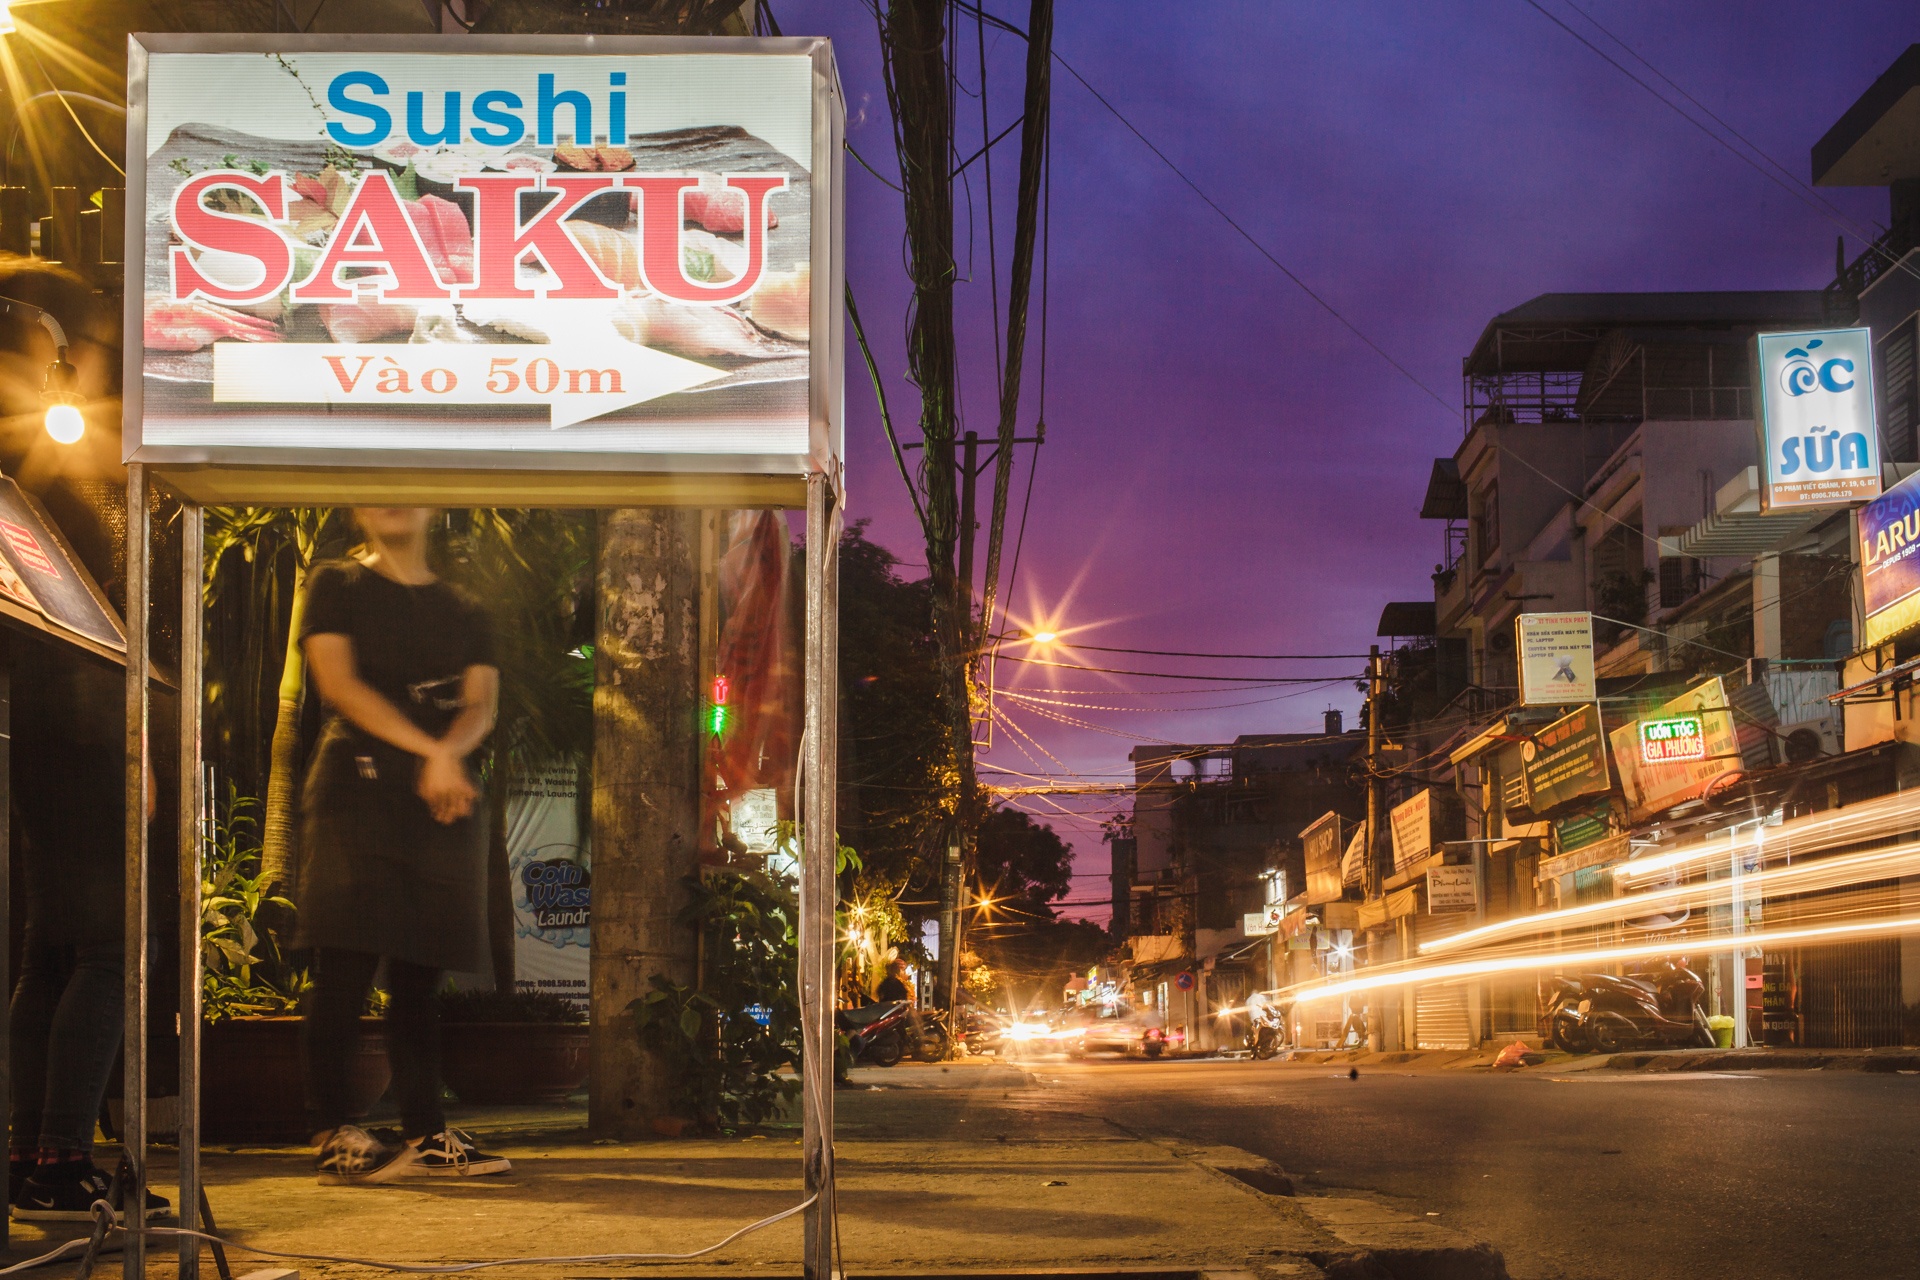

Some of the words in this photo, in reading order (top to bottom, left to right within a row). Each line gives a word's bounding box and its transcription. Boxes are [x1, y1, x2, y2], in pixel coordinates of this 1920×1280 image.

[326, 71, 627, 148] Sushi
[170, 172, 788, 302] SAKU
[322, 355, 458, 394] Vào
[486, 357, 627, 394] 50m
[1780, 425, 1869, 475] SỮA
[1783, 484, 1802, 494] PHẠM
[1802, 481, 1817, 491] VIẾT
[1882, 553, 1902, 570] DEPUIS
[1649, 722, 1672, 740] UỐN
[1672, 720, 1695, 737] TÓC
[1647, 741, 1664, 758] GIA
[522, 861, 583, 885] Coin
[532, 884, 591, 908] Was
